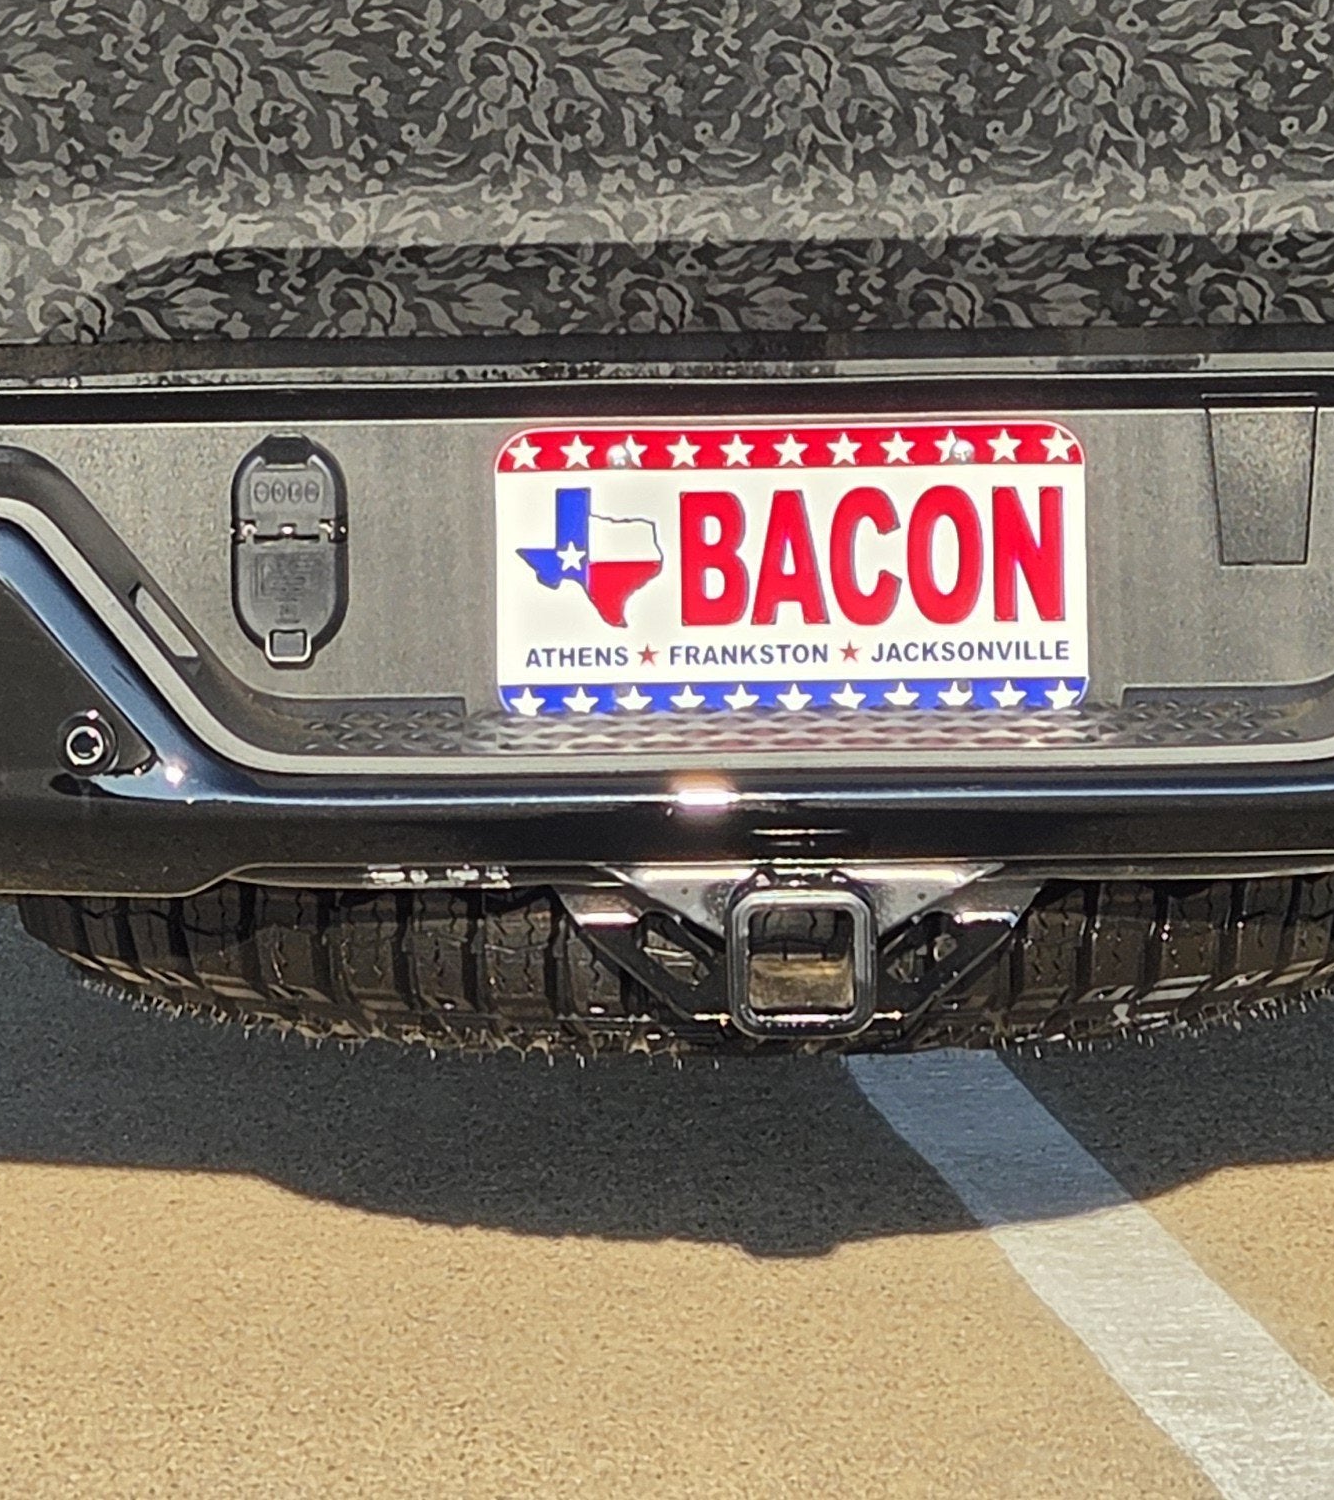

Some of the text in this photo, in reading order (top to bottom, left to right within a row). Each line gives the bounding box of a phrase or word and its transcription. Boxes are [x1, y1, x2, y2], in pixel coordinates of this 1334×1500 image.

[679, 485, 1067, 627] BACON
[525, 639, 1071, 669] ATHENS FRANKSTON JACKSONVILLE
